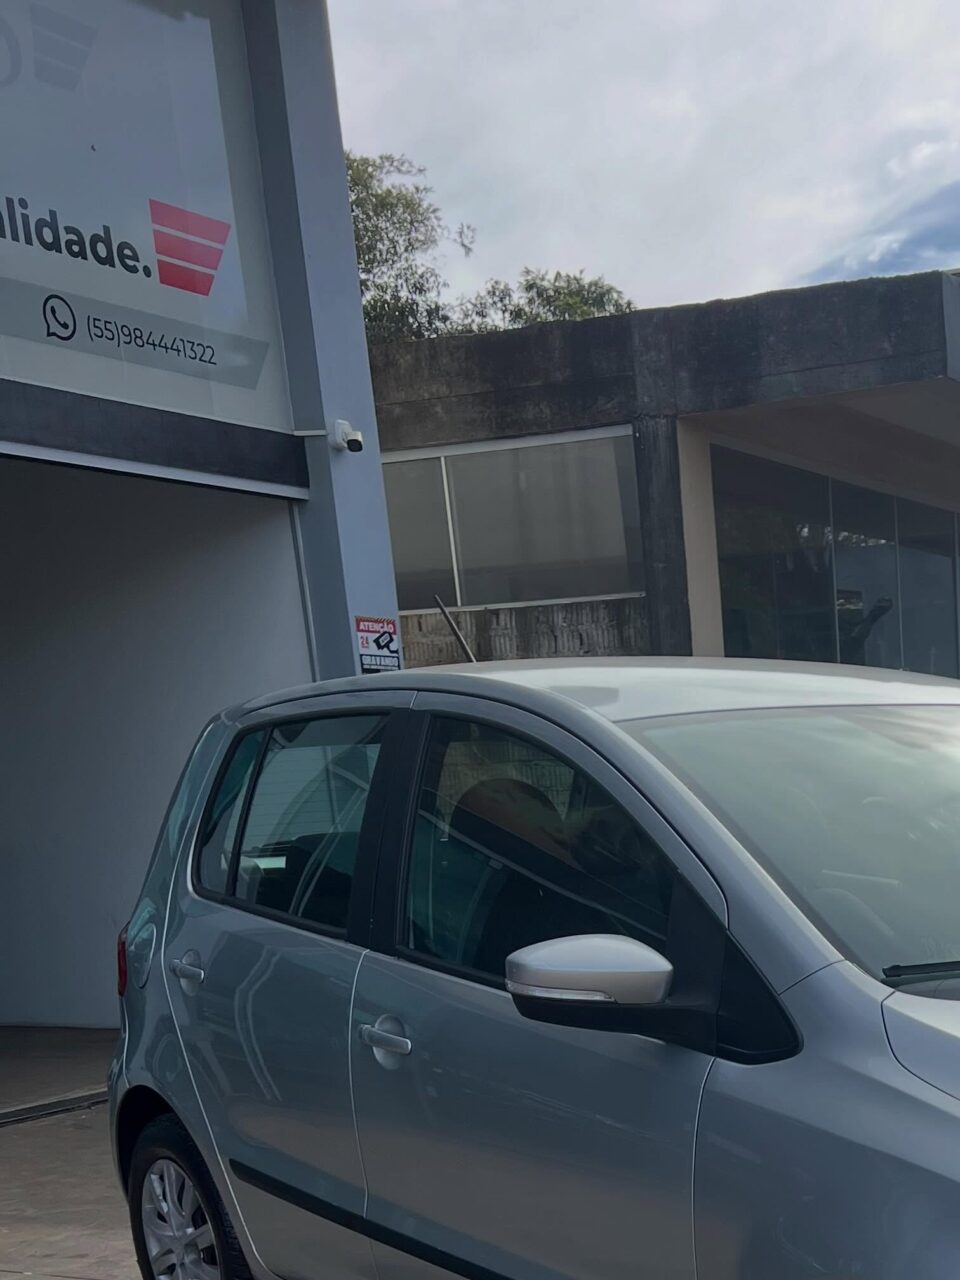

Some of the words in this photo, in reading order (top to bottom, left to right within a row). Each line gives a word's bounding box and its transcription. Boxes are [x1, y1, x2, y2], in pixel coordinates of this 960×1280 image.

[0, 196, 152, 278] lidade.
[87, 315, 217, 366] (55)984441322
[360, 621, 394, 633] ATENÇÃO
